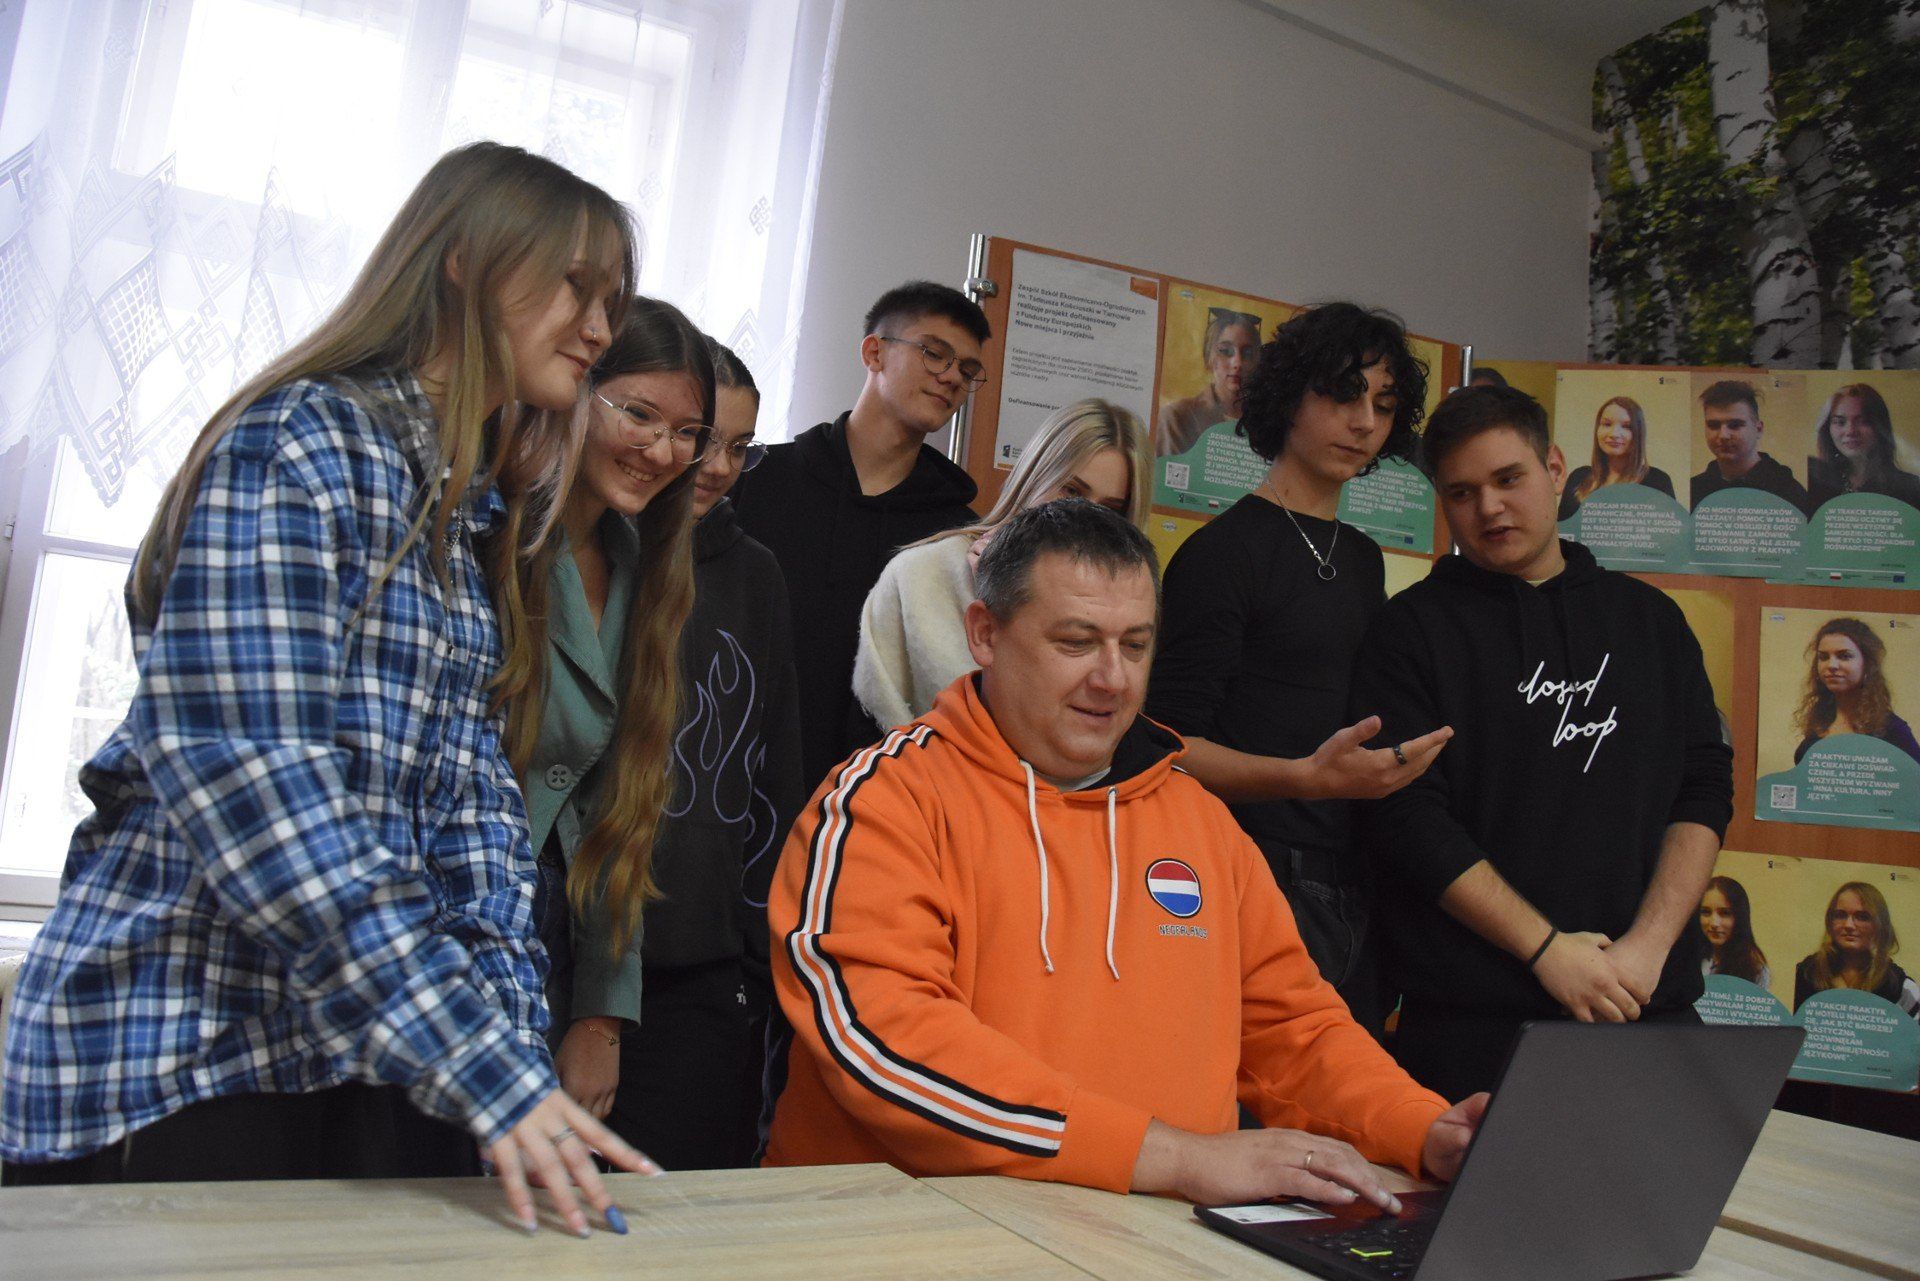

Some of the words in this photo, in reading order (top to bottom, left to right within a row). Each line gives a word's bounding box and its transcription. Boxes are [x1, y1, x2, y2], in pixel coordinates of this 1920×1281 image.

[1041, 288, 1060, 298] Szkół
[1030, 294, 1059, 307] Tadeusza
[1061, 301, 1096, 314] Kościuszki
[1103, 310, 1131, 322] Tarnowie
[1017, 302, 1044, 315] realizuje
[1045, 308, 1069, 319] projekt
[1070, 312, 1117, 328] dofinansowany
[1016, 319, 1033, 329] Nowe
[1034, 324, 1058, 335] miejsca
[1022, 311, 1051, 325] Funduszy
[1052, 318, 1092, 332] Europejskich
[1008, 397, 1051, 409] Dofinansowanie
[1736, 515, 1765, 523] POMOC
[1695, 545, 1749, 553] ZADOWOLONY
[1552, 693, 1618, 774] loop
[1808, 760, 1819, 768] ZA
[1821, 761, 1856, 771] CIEKAWE
[1851, 755, 1889, 764] UWAŻAM
[1808, 768, 1838, 778] CZENIE,
[1846, 771, 1876, 780] PRZEDE
[1808, 776, 1855, 786] WSZYSTKIM
[1855, 779, 1900, 790] WYZWANIE
[1812, 785, 1833, 793] INNA
[1833, 786, 1872, 796] KULTURA,
[1873, 789, 1893, 797] INNY
[1733, 993, 1744, 1002] ŻE
[1745, 995, 1776, 1006] DOBRZE
[1745, 1003, 1772, 1013] SWOJE
[1848, 1005, 1887, 1015] PRAKTYK
[1730, 1010, 1781, 1022] WYKAZAŁAM
[1815, 1010, 1846, 1019] HOTELU
[1846, 1013, 1899, 1025] NAUCZYŁAM
[1837, 1019, 1854, 1029] BYĆ
[1854, 1023, 1893, 1033] BARDZIEJ
[1832, 1044, 1890, 1058] UMIEJĘTNOŚCI
